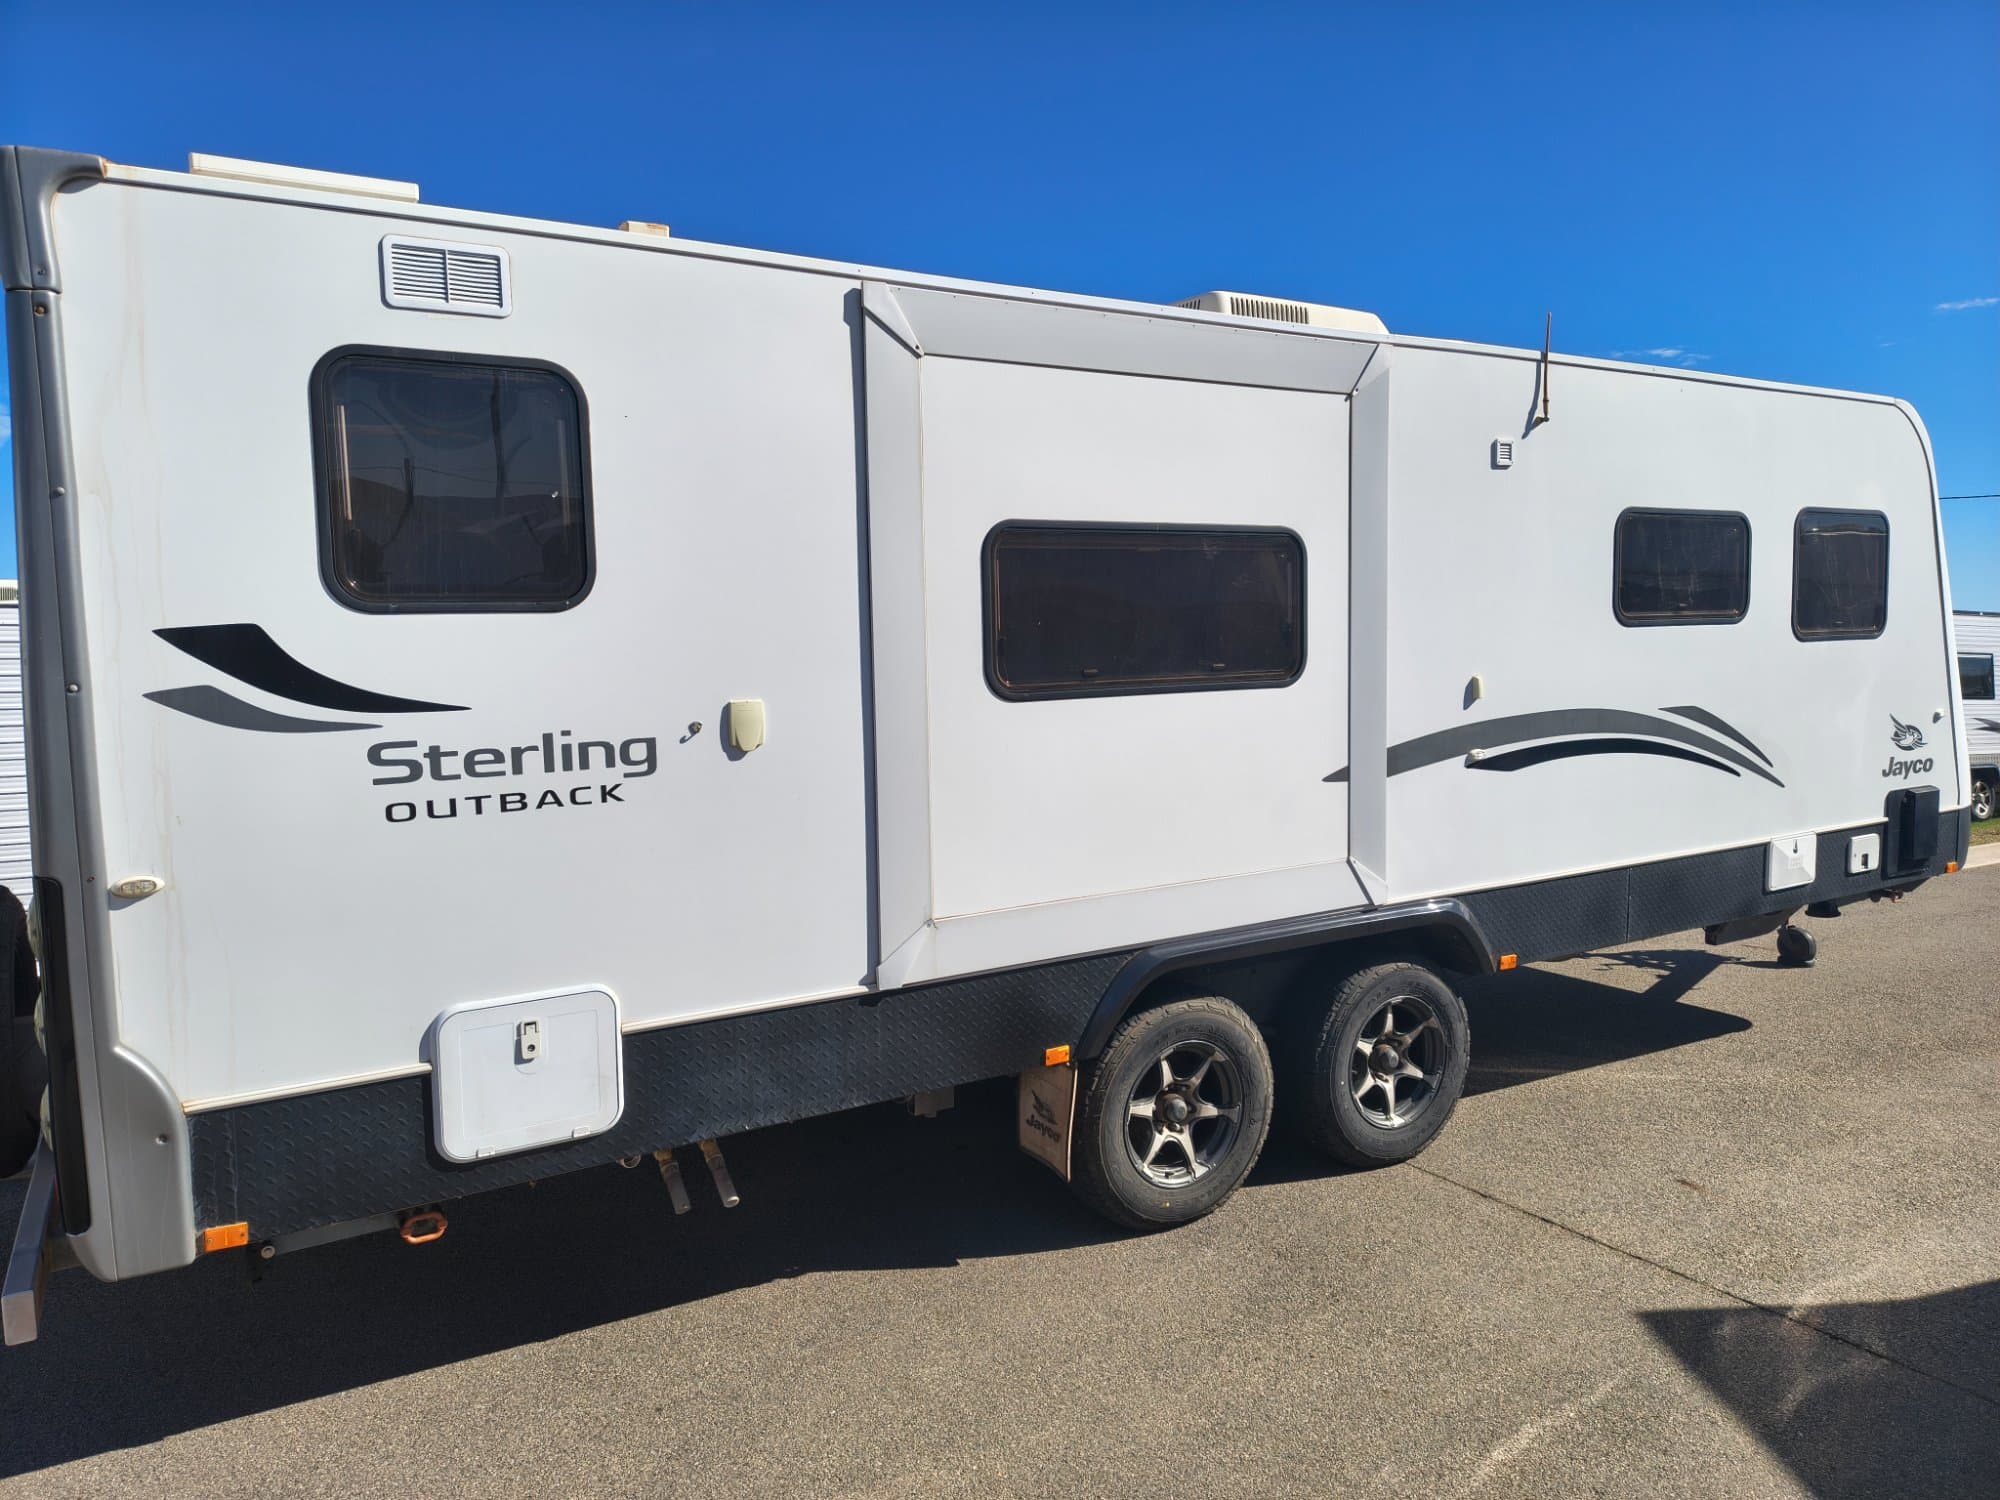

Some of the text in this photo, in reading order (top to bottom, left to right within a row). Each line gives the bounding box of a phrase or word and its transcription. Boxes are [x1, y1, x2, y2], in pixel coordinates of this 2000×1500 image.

[367, 730, 657, 785] Sterling
[1882, 756, 1934, 780] Jayco
[385, 783, 625, 823] OUTBACK
